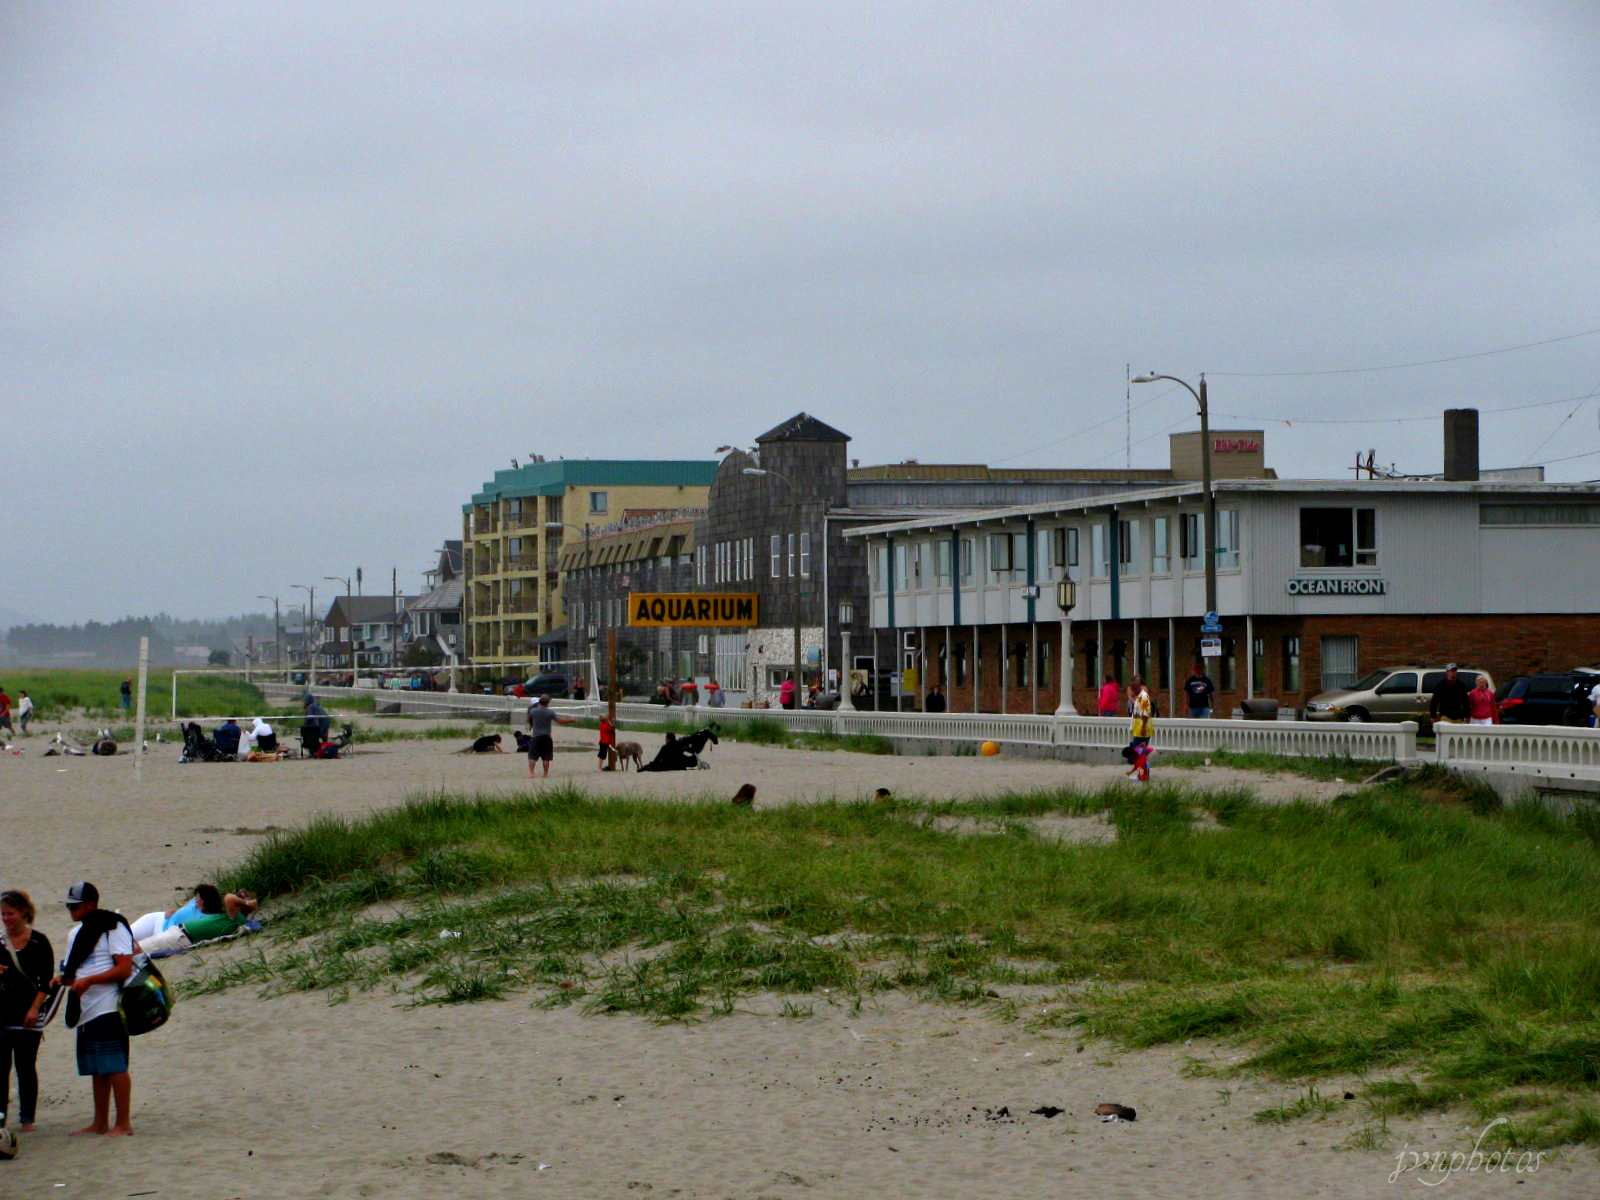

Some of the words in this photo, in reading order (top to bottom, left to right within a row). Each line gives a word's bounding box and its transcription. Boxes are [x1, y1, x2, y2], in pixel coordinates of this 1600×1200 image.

[1287, 580, 1339, 595] OCEAN
[1341, 580, 1388, 594] FRONT
[636, 598, 753, 622] AQUARIUM
